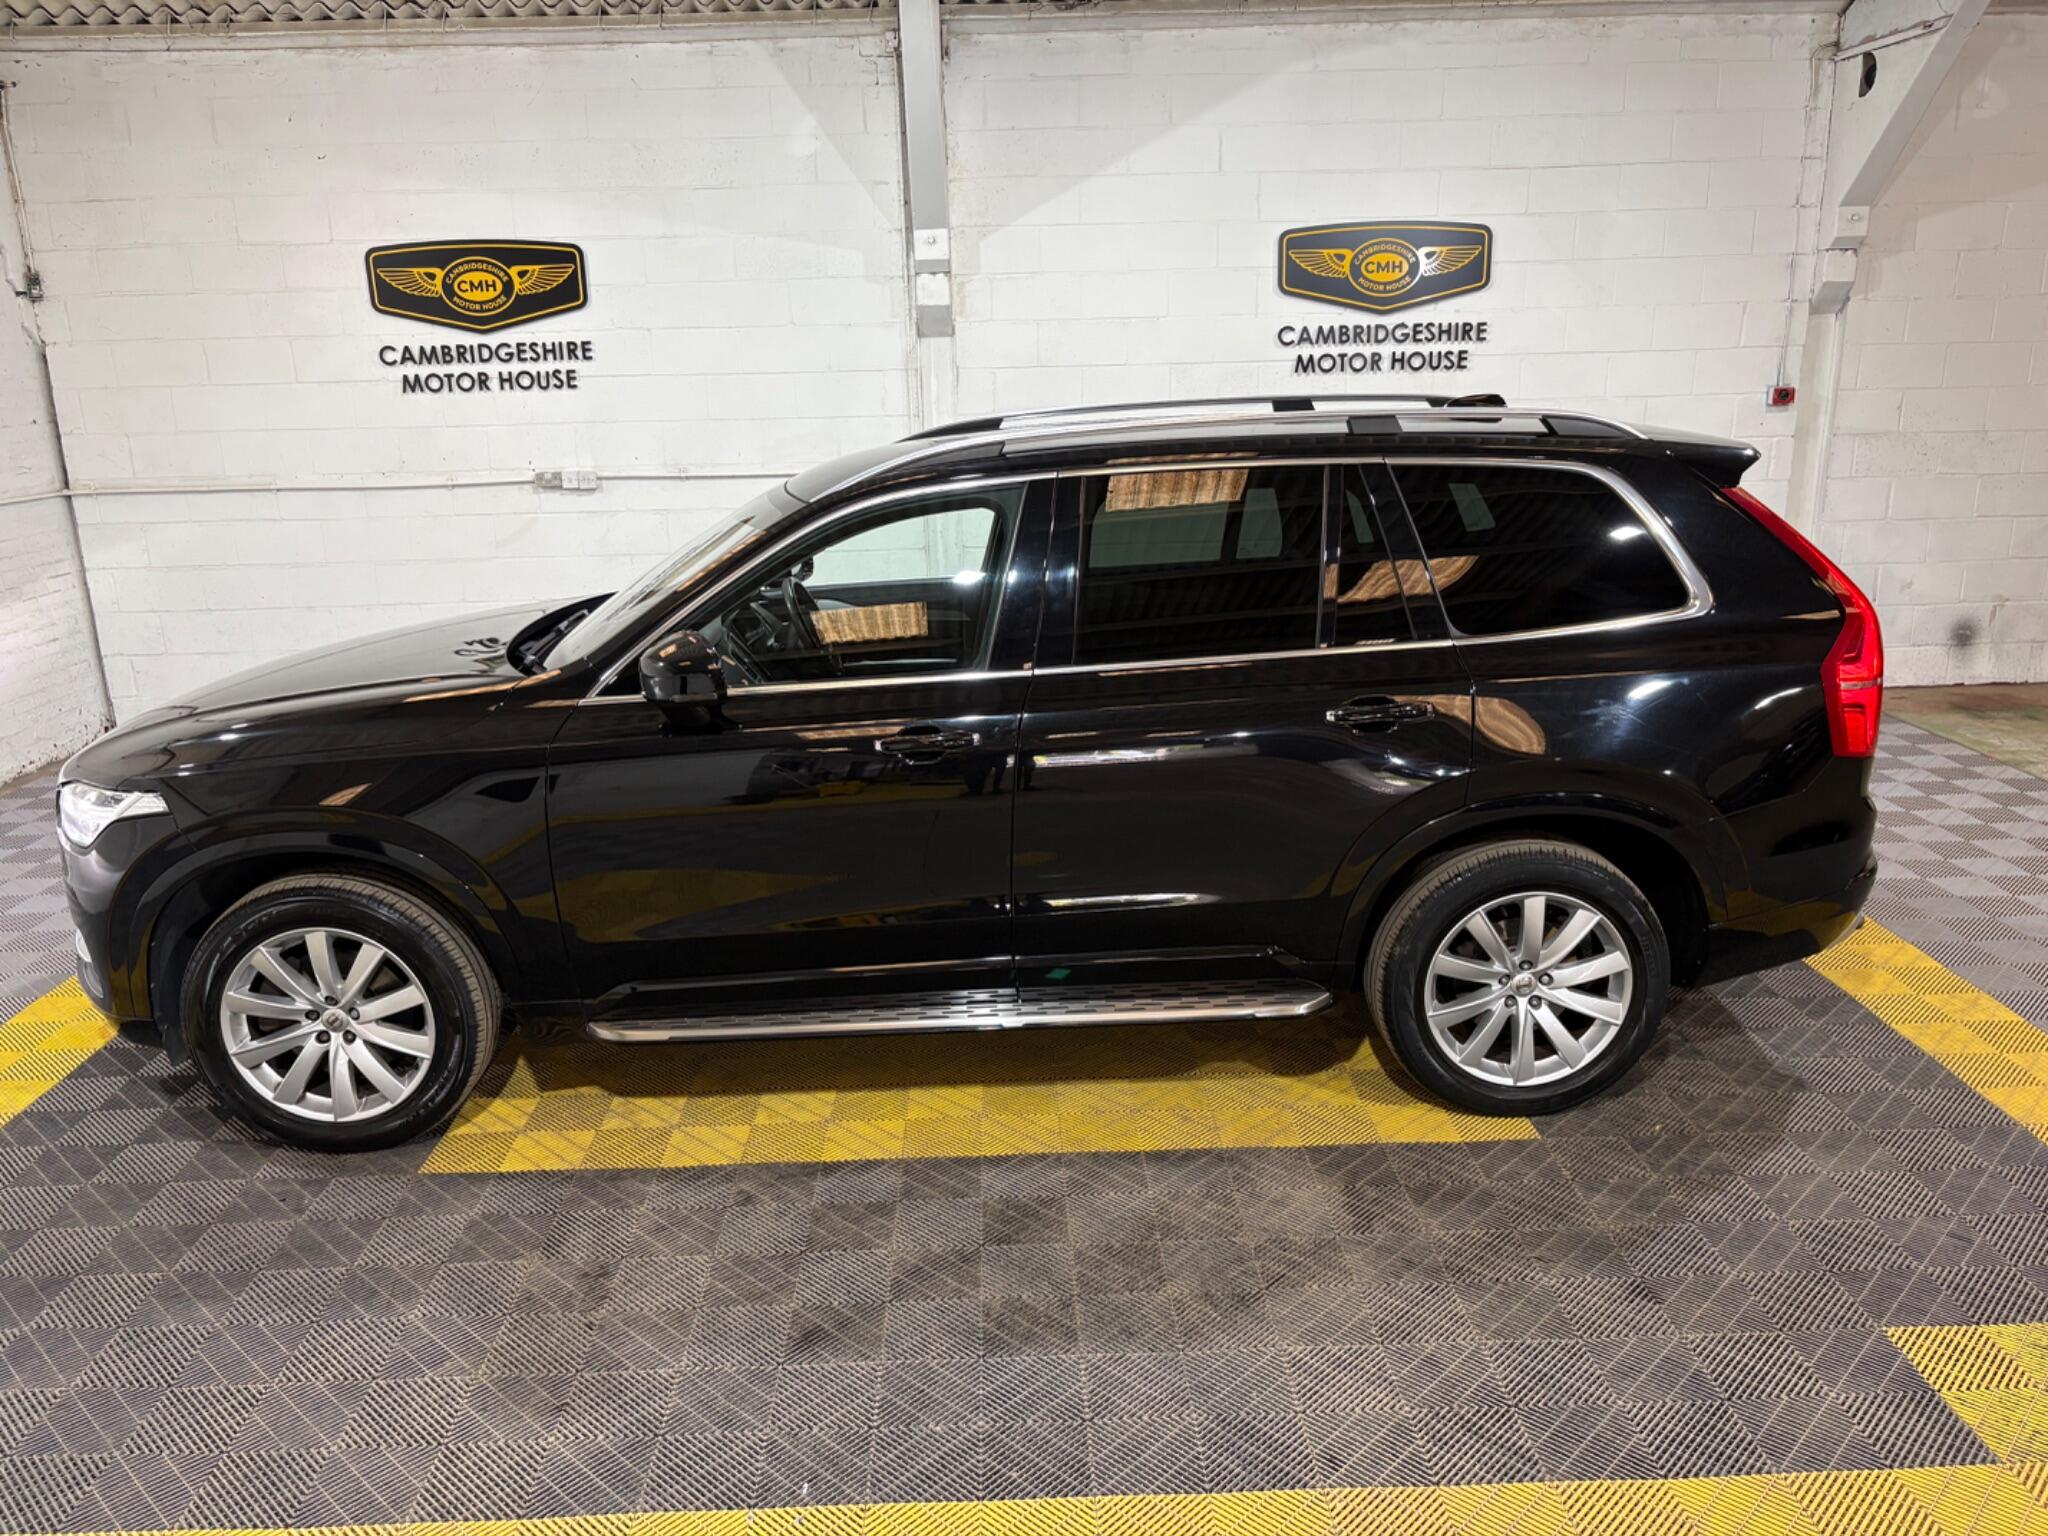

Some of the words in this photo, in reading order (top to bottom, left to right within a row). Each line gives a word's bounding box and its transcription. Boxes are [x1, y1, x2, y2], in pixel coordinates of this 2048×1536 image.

[1354, 243, 1415, 265] CAMBRIDGESHIRE
[446, 262, 509, 284] CAMBRIDGESHIRE
[1364, 260, 1404, 274] CMH
[457, 279, 497, 293] CMH
[1358, 276, 1385, 291] MOTOR
[1386, 276, 1411, 291] HOUSE
[453, 296, 481, 311] MOTOR
[482, 295, 507, 310] HOUSE
[1278, 322, 1488, 346] CAMBRIDGESHIRE
[379, 341, 593, 366] CAMBRIDGESHIRE
[1295, 352, 1382, 373] MOTOR
[1391, 350, 1469, 371] HOUSE
[402, 373, 491, 394] MOTOR
[499, 369, 578, 390] HOUSE
